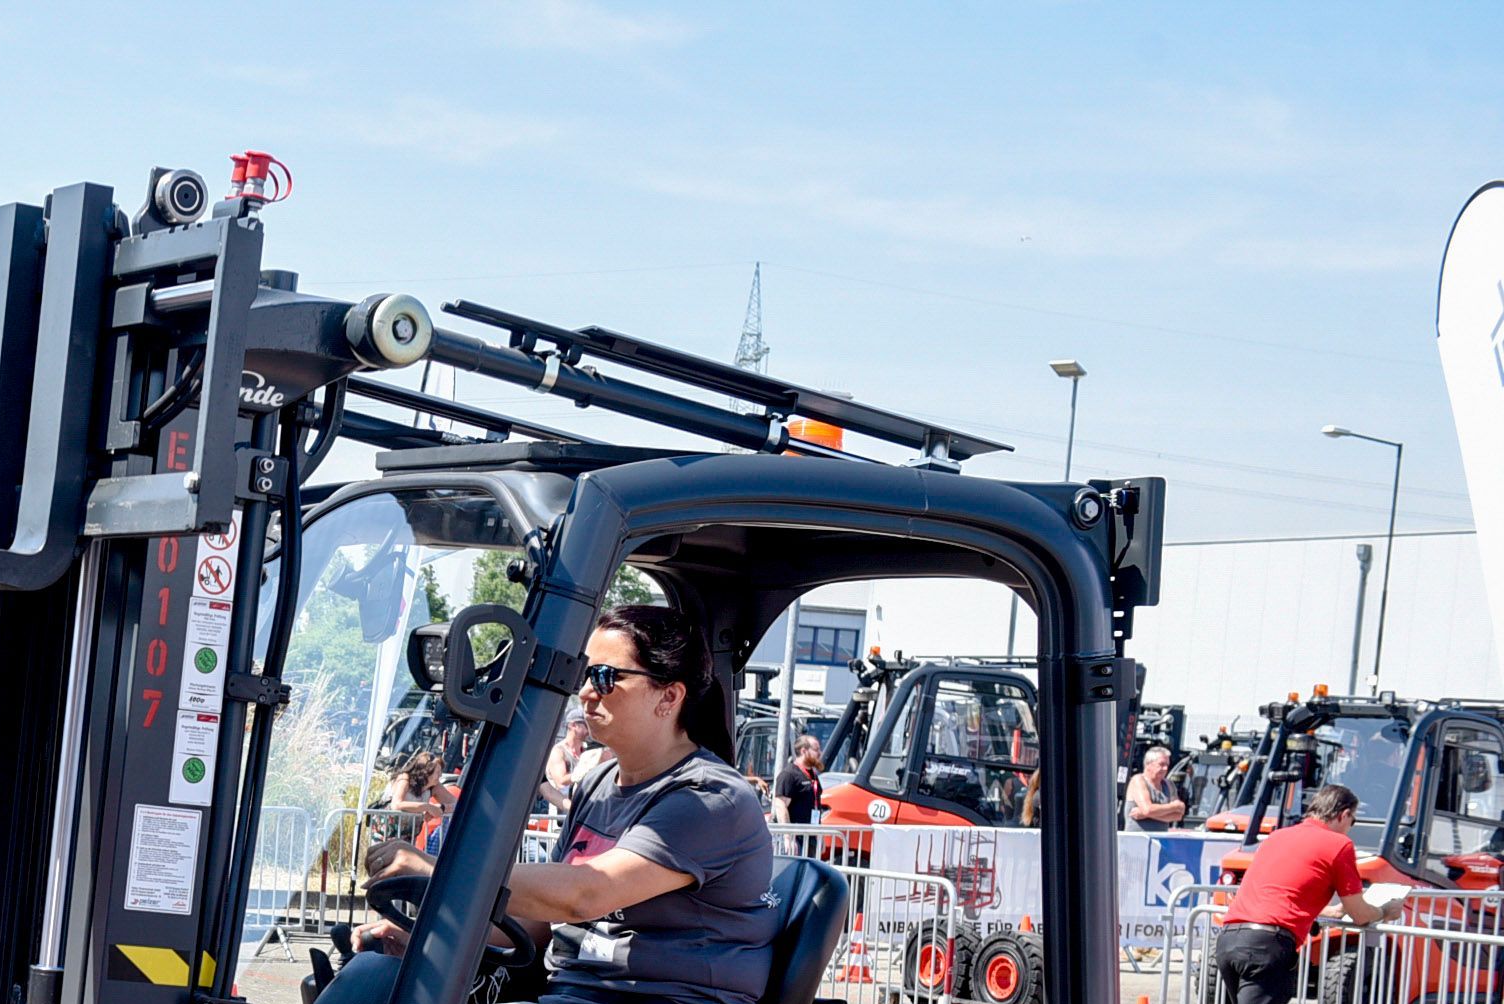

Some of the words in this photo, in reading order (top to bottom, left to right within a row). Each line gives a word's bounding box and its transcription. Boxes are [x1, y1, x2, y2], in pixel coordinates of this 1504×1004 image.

[238, 370, 285, 407] nde
[142, 431, 190, 728] E0107
[872, 803, 886, 819] 20
